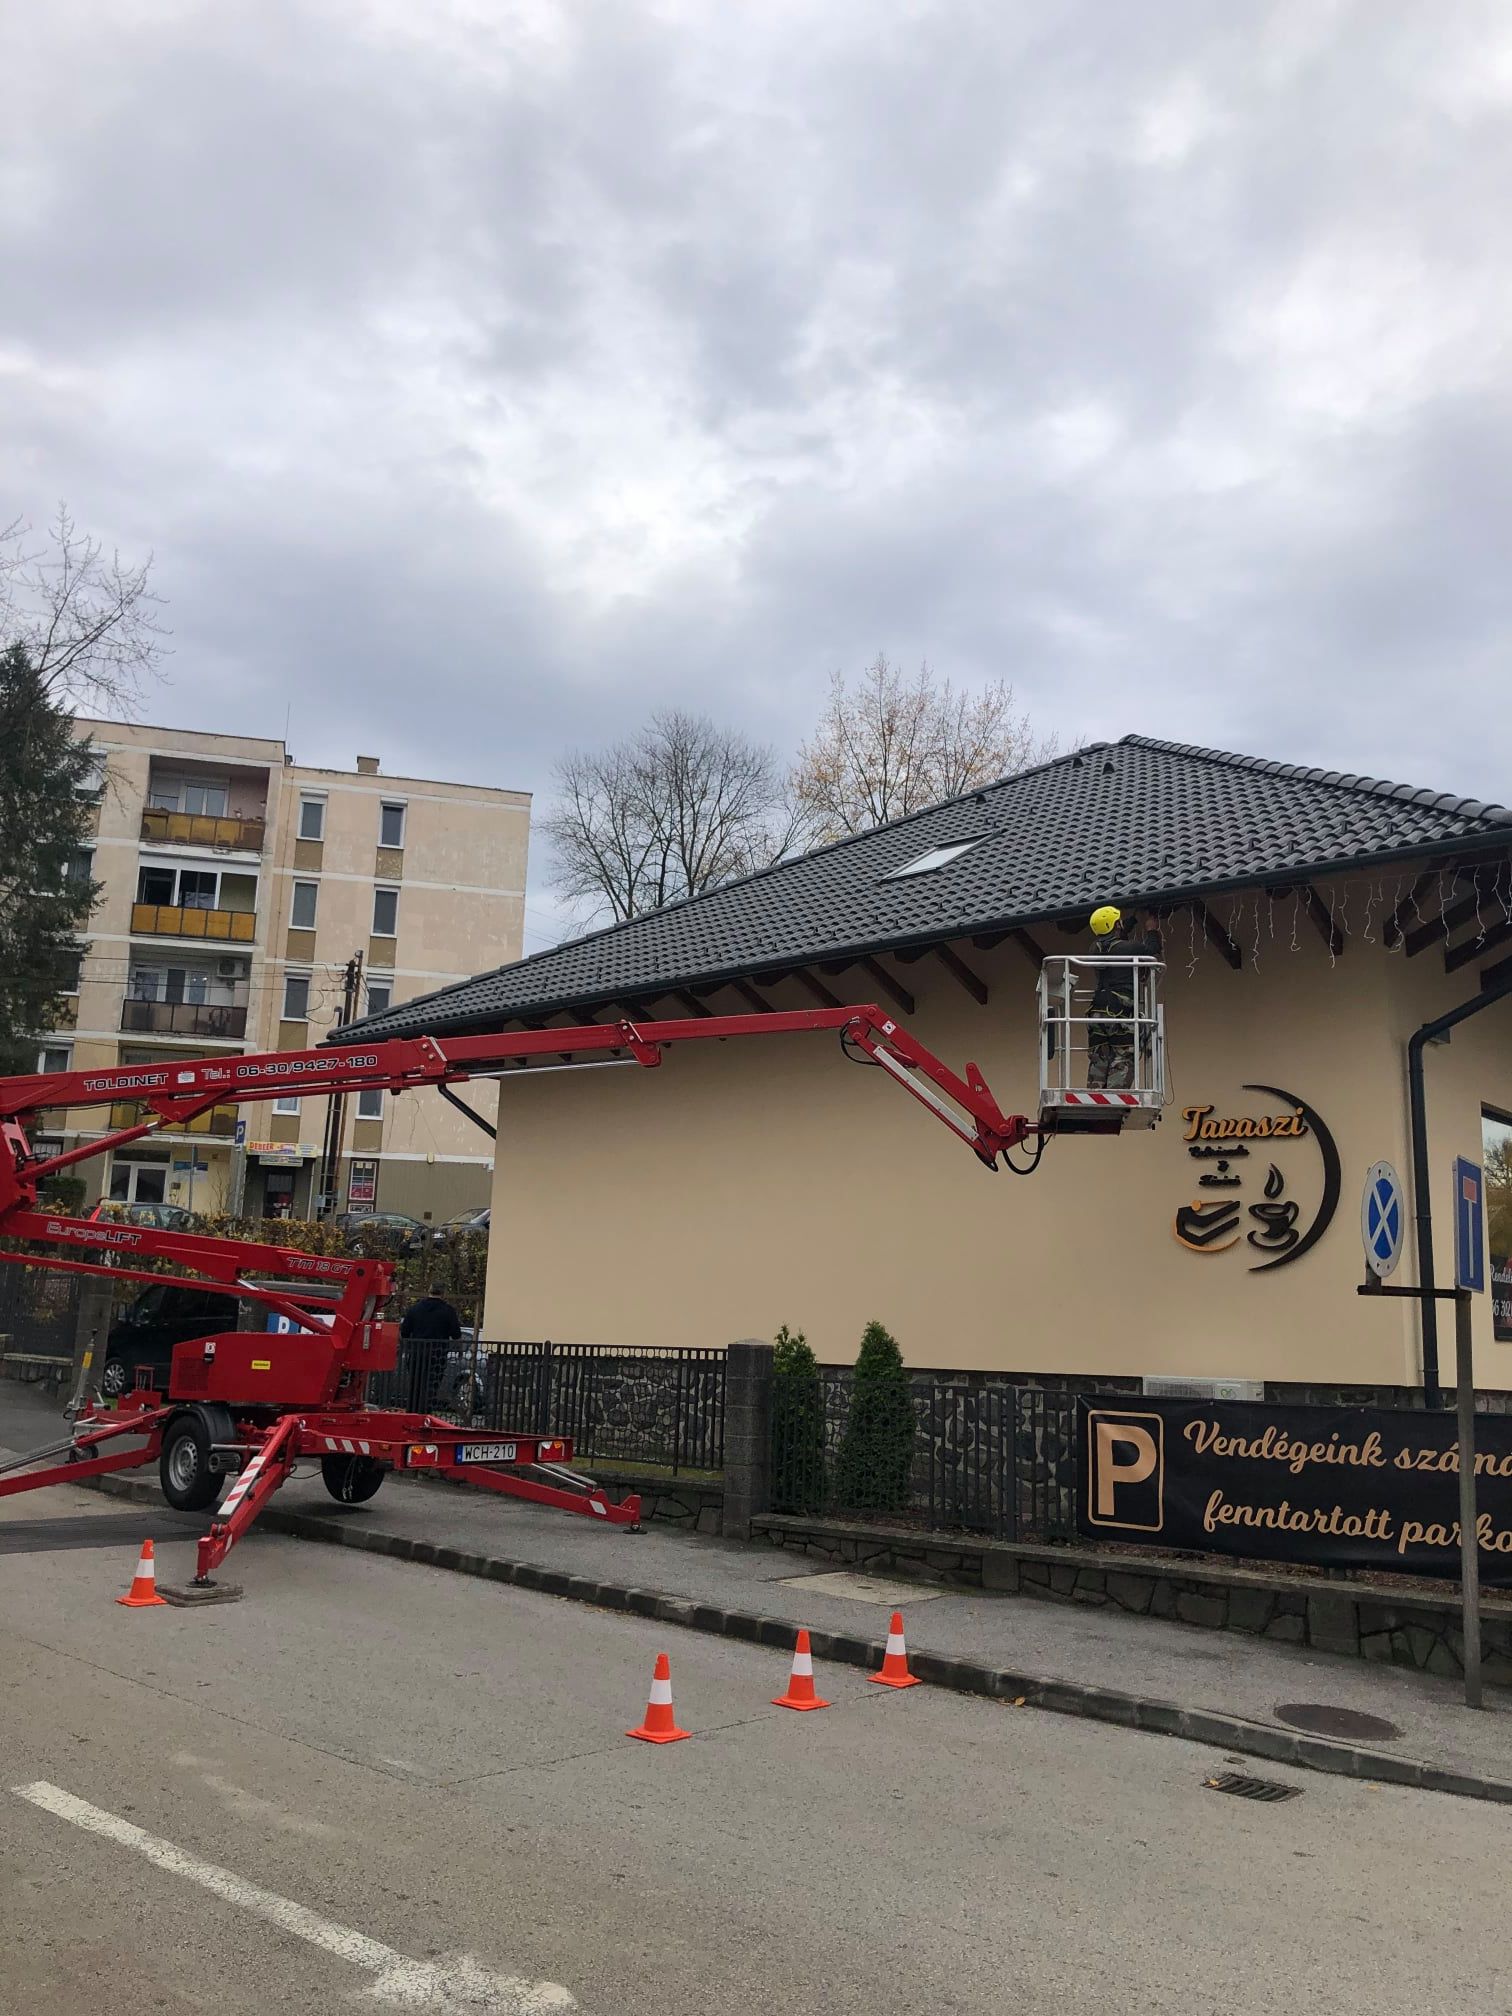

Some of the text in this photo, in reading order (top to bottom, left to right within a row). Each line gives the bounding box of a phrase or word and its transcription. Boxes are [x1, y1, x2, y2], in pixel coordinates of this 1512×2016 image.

[84, 1073, 168, 1091] TOLDINET
[201, 1067, 231, 1080] Tel.:
[236, 1055, 377, 1078] 06-30/9427-180
[236, 1125, 245, 1141] P
[1182, 1104, 1308, 1140] Tavaszi
[464, 1445, 514, 1460] WCH-210
[1183, 1420, 1387, 1474] Vendégeink
[1097, 1423, 1157, 1515] P
[1203, 1489, 1394, 1540] fenntartott
